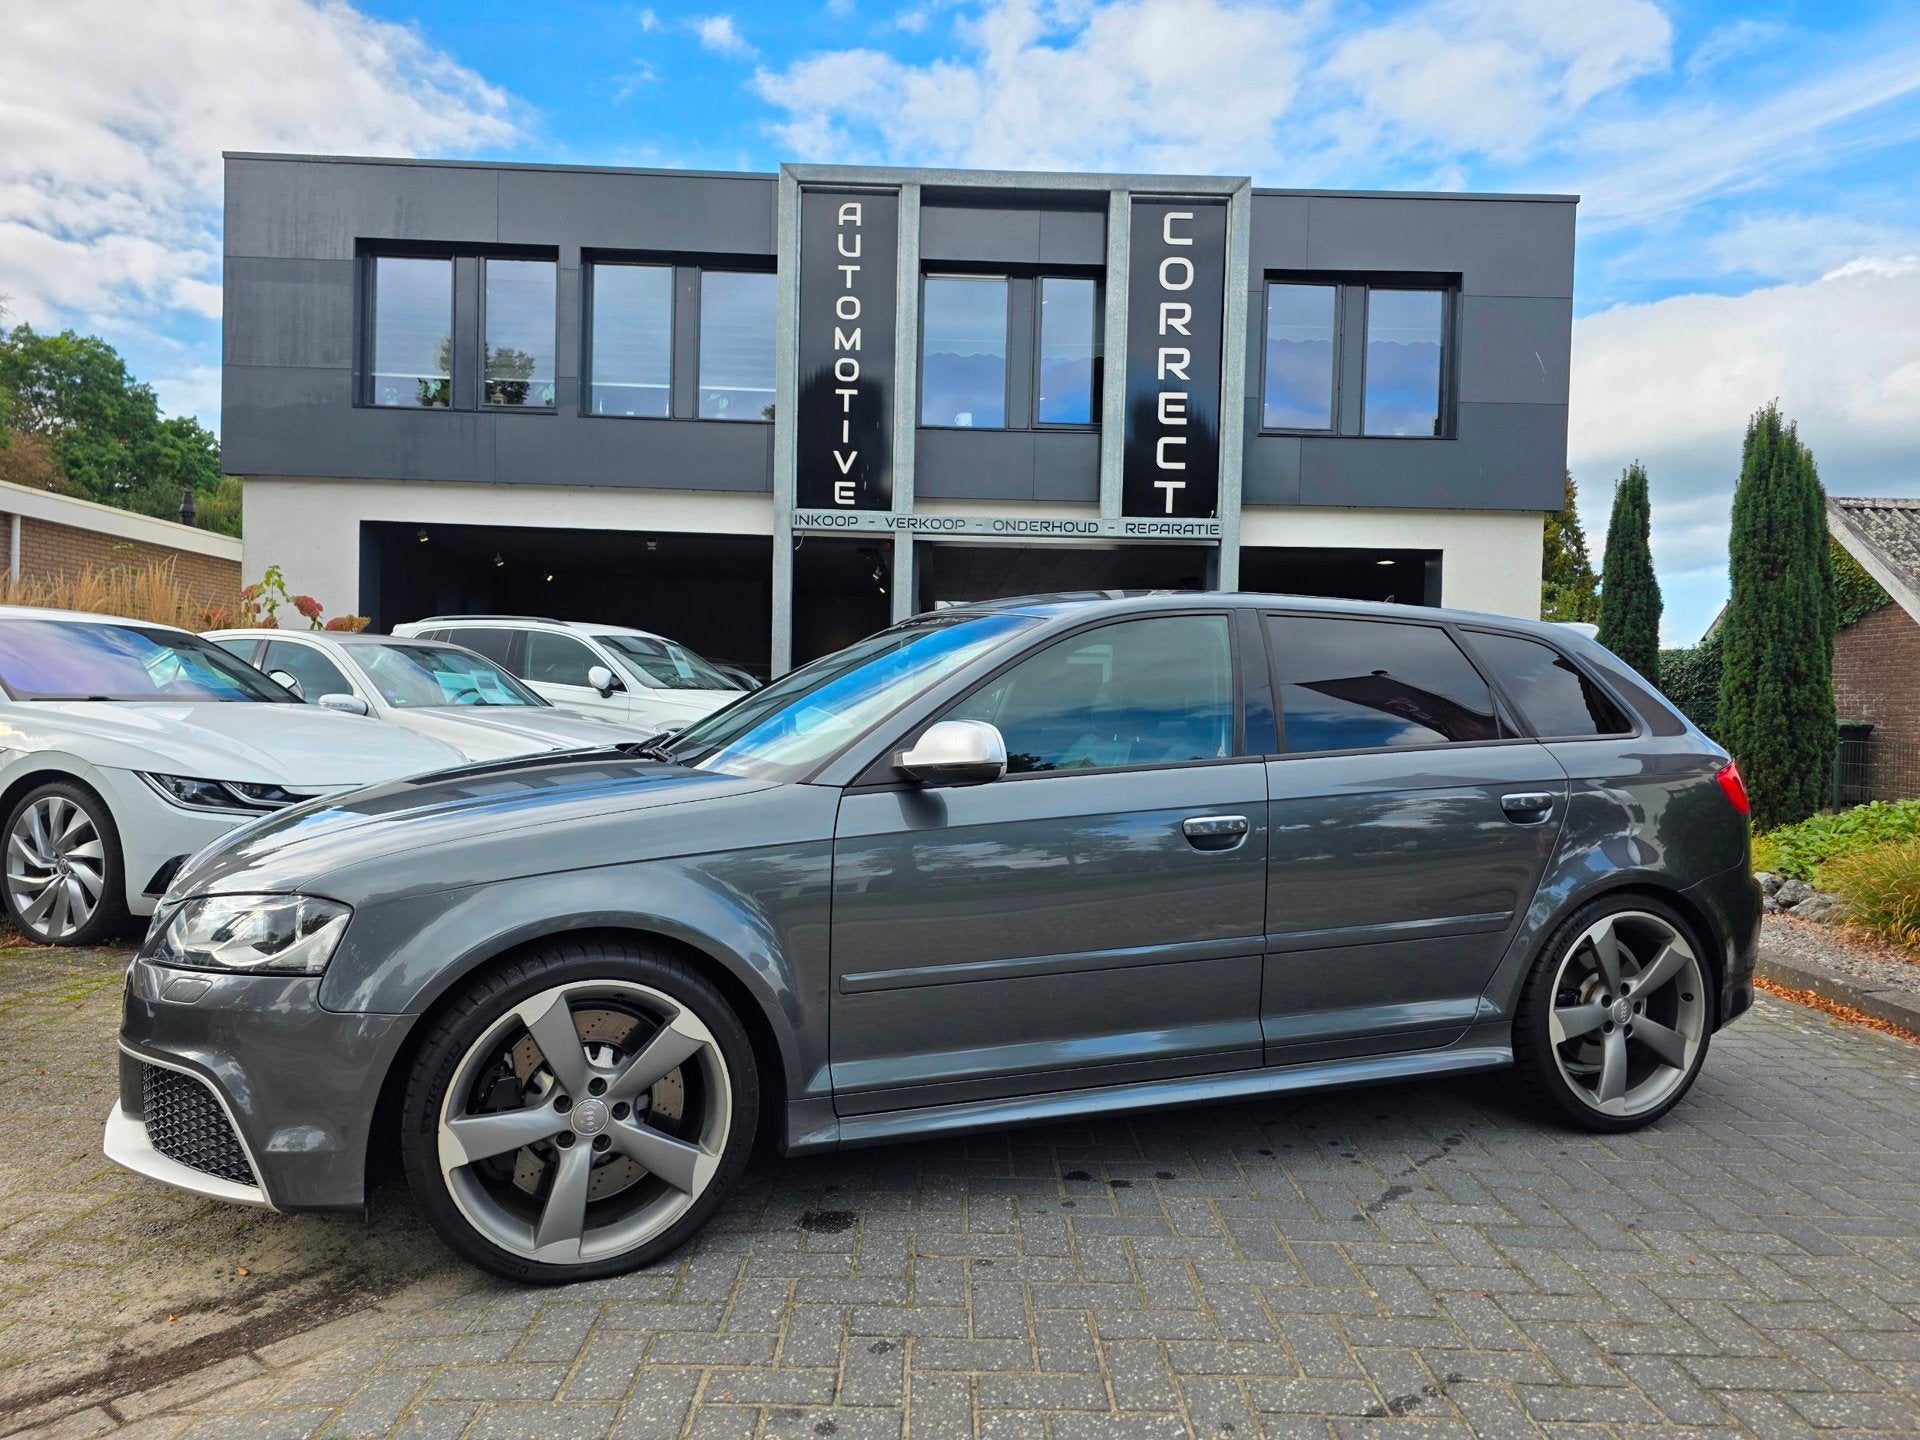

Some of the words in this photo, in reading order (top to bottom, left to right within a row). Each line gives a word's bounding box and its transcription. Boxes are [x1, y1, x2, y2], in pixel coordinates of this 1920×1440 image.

[833, 202, 862, 505] AUTOMOTIVE
[1153, 211, 1195, 514] CORRECT
[794, 514, 859, 527] INKOOP
[884, 517, 966, 530] VERKOOP
[992, 519, 1099, 533] ONDERHOUD
[1124, 522, 1220, 535] REPARATIE
